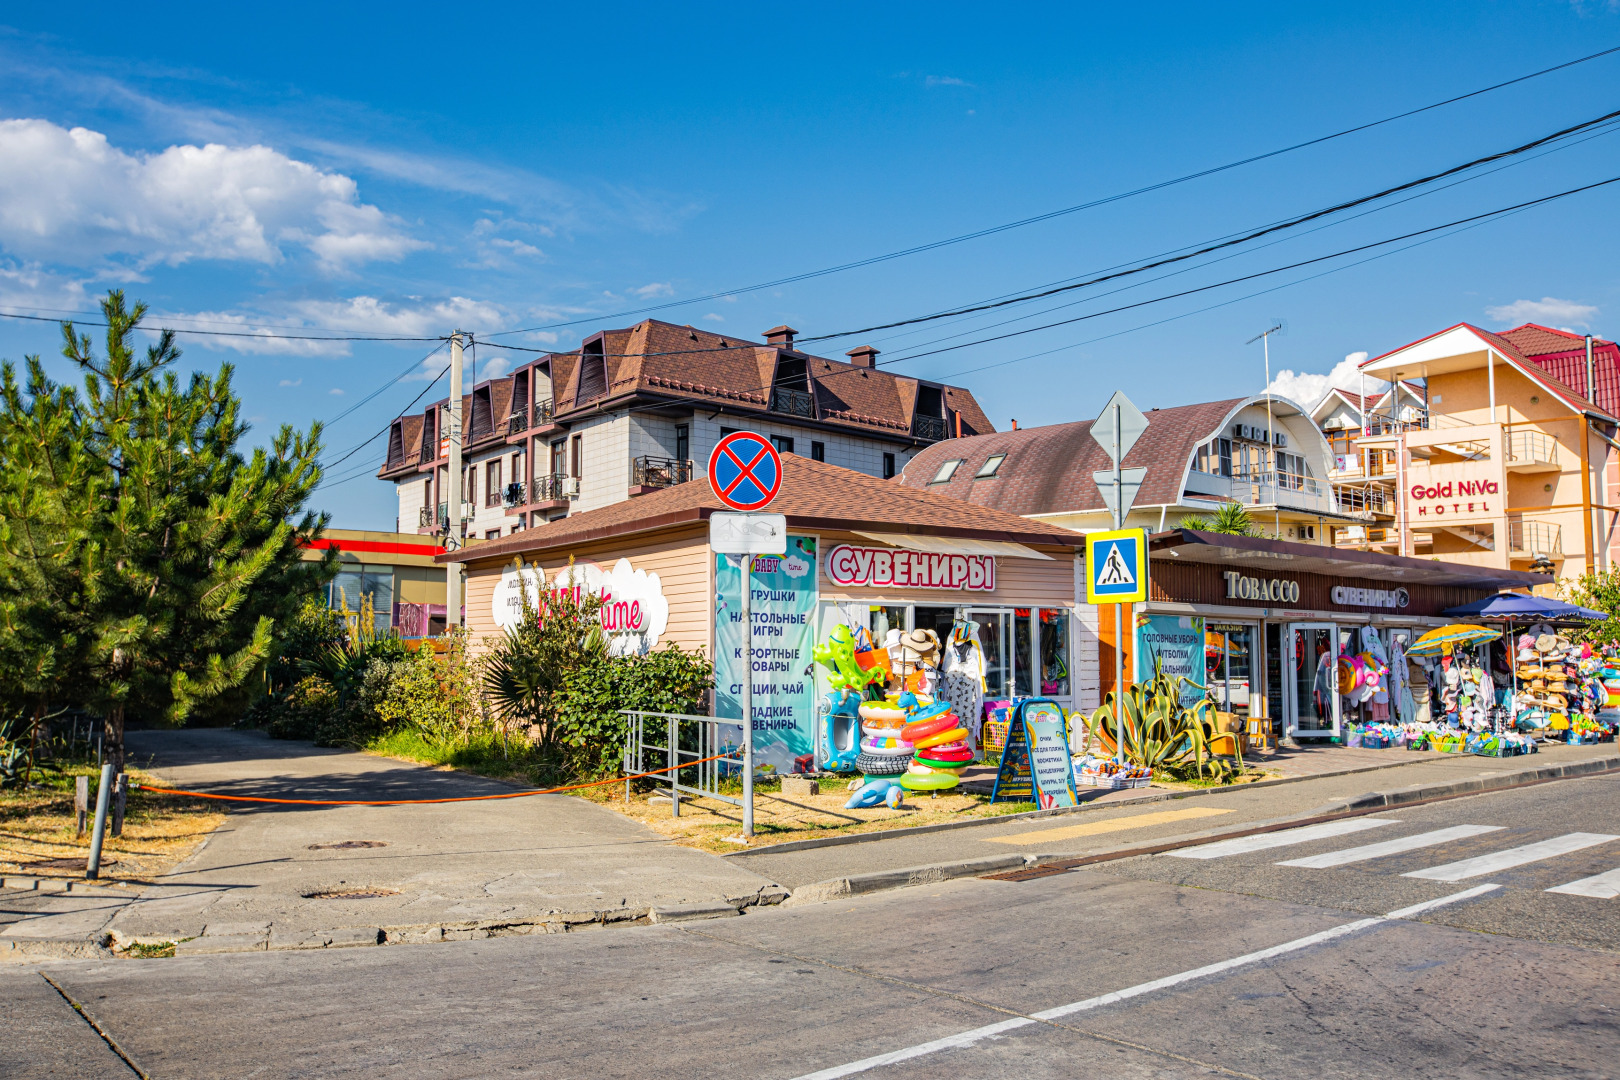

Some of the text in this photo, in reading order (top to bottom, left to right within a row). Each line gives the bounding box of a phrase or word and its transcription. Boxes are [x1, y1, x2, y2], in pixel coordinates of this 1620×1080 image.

[1411, 479, 1498, 499] Gold NiVa
[1419, 501, 1489, 516] HOTEL
[754, 558, 779, 573] BABY
[788, 562, 803, 571] time
[830, 546, 994, 589] СУВЕНИРЫ
[750, 590, 795, 602] ГРУШКИ
[1331, 585, 1397, 608] СУВЕНИРЫ
[600, 586, 643, 630] time
[754, 625, 783, 637] ИГРЫ
[1143, 633, 1199, 644] ГОЛОВНЫЕ УБОРЫ
[734, 647, 800, 659] КРОРТНЫЕ
[750, 661, 790, 672] ОВАРЫ
[1152, 665, 1193, 674] КПАЛЬНИКИ
[730, 681, 804, 697] СПЦИИ, ЧАЙ
[741, 706, 793, 719] ЛАДКИЕ
[737, 719, 797, 731] ВЕНИРЫ
